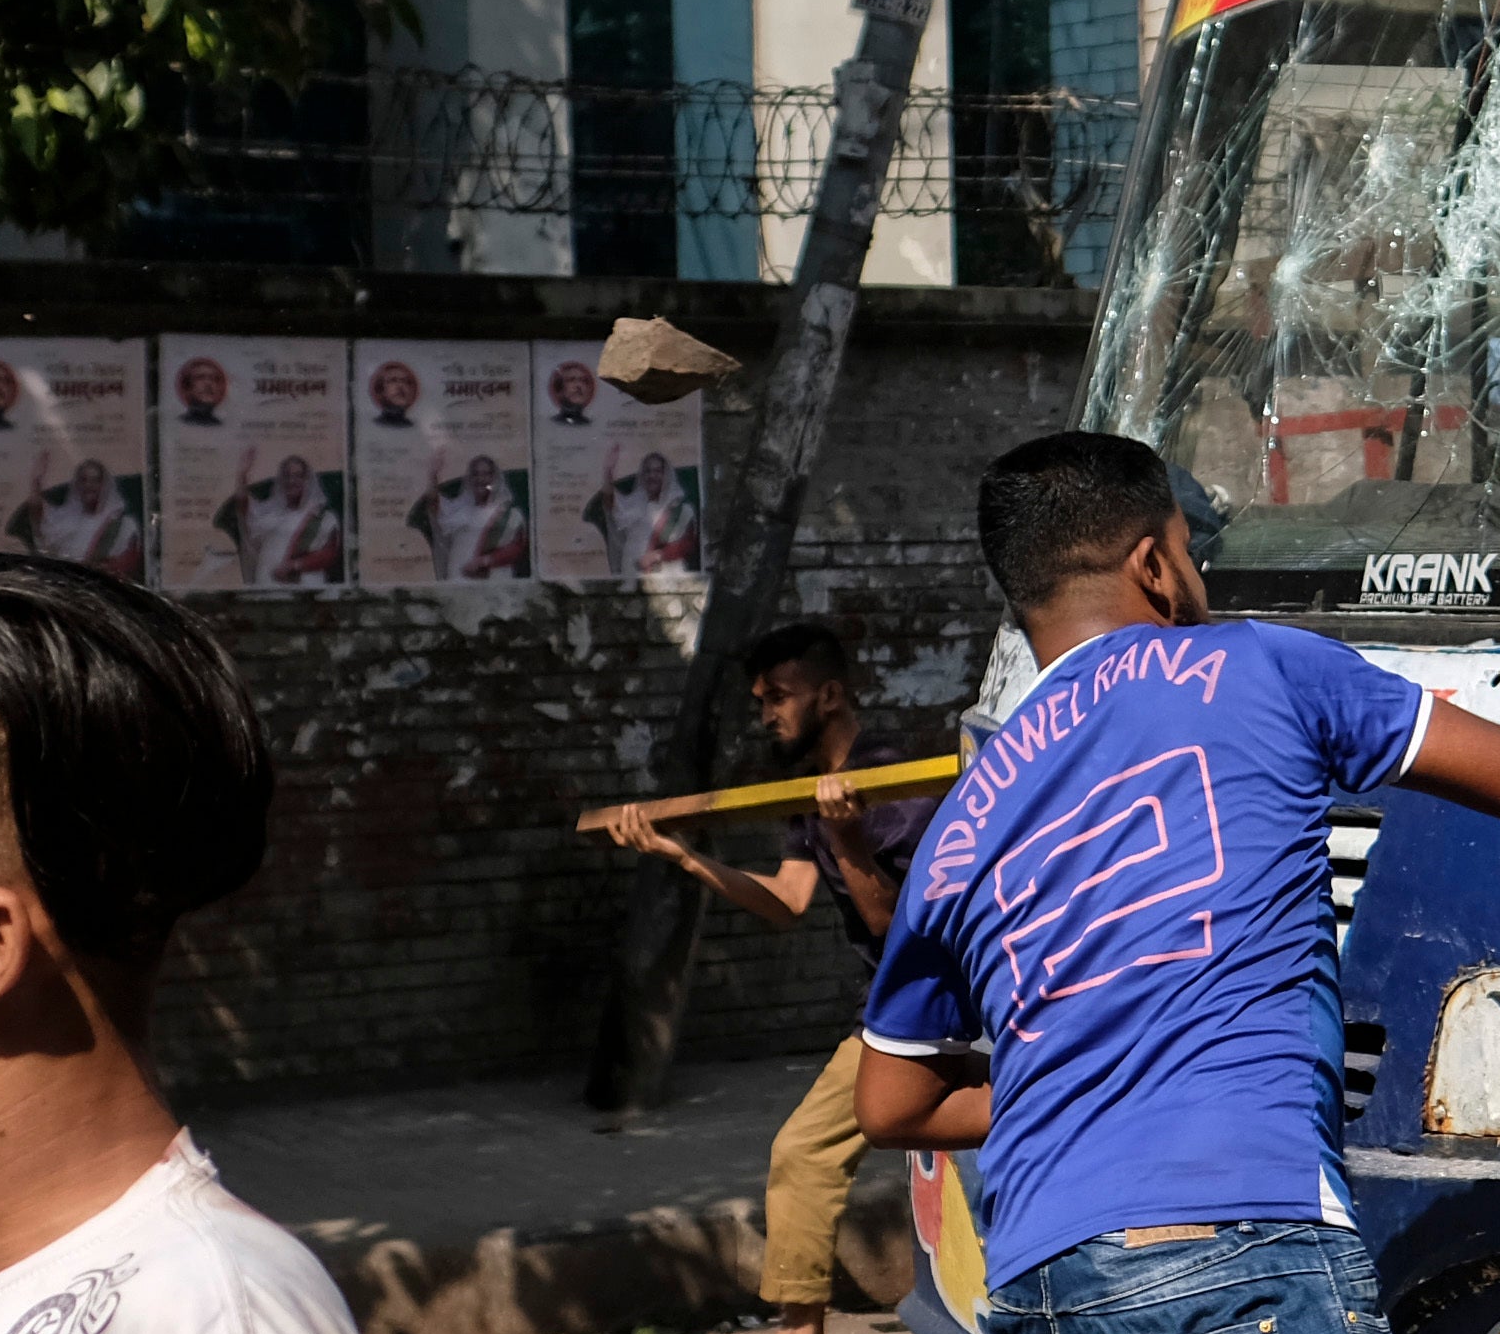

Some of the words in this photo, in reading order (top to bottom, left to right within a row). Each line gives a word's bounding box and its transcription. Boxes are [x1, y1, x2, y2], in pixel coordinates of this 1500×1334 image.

[1360, 553, 1499, 592] KRANK
[1359, 592, 1409, 605] PREMIUM
[1436, 593, 1491, 607] BATTERY
[1093, 638, 1228, 705] RANA
